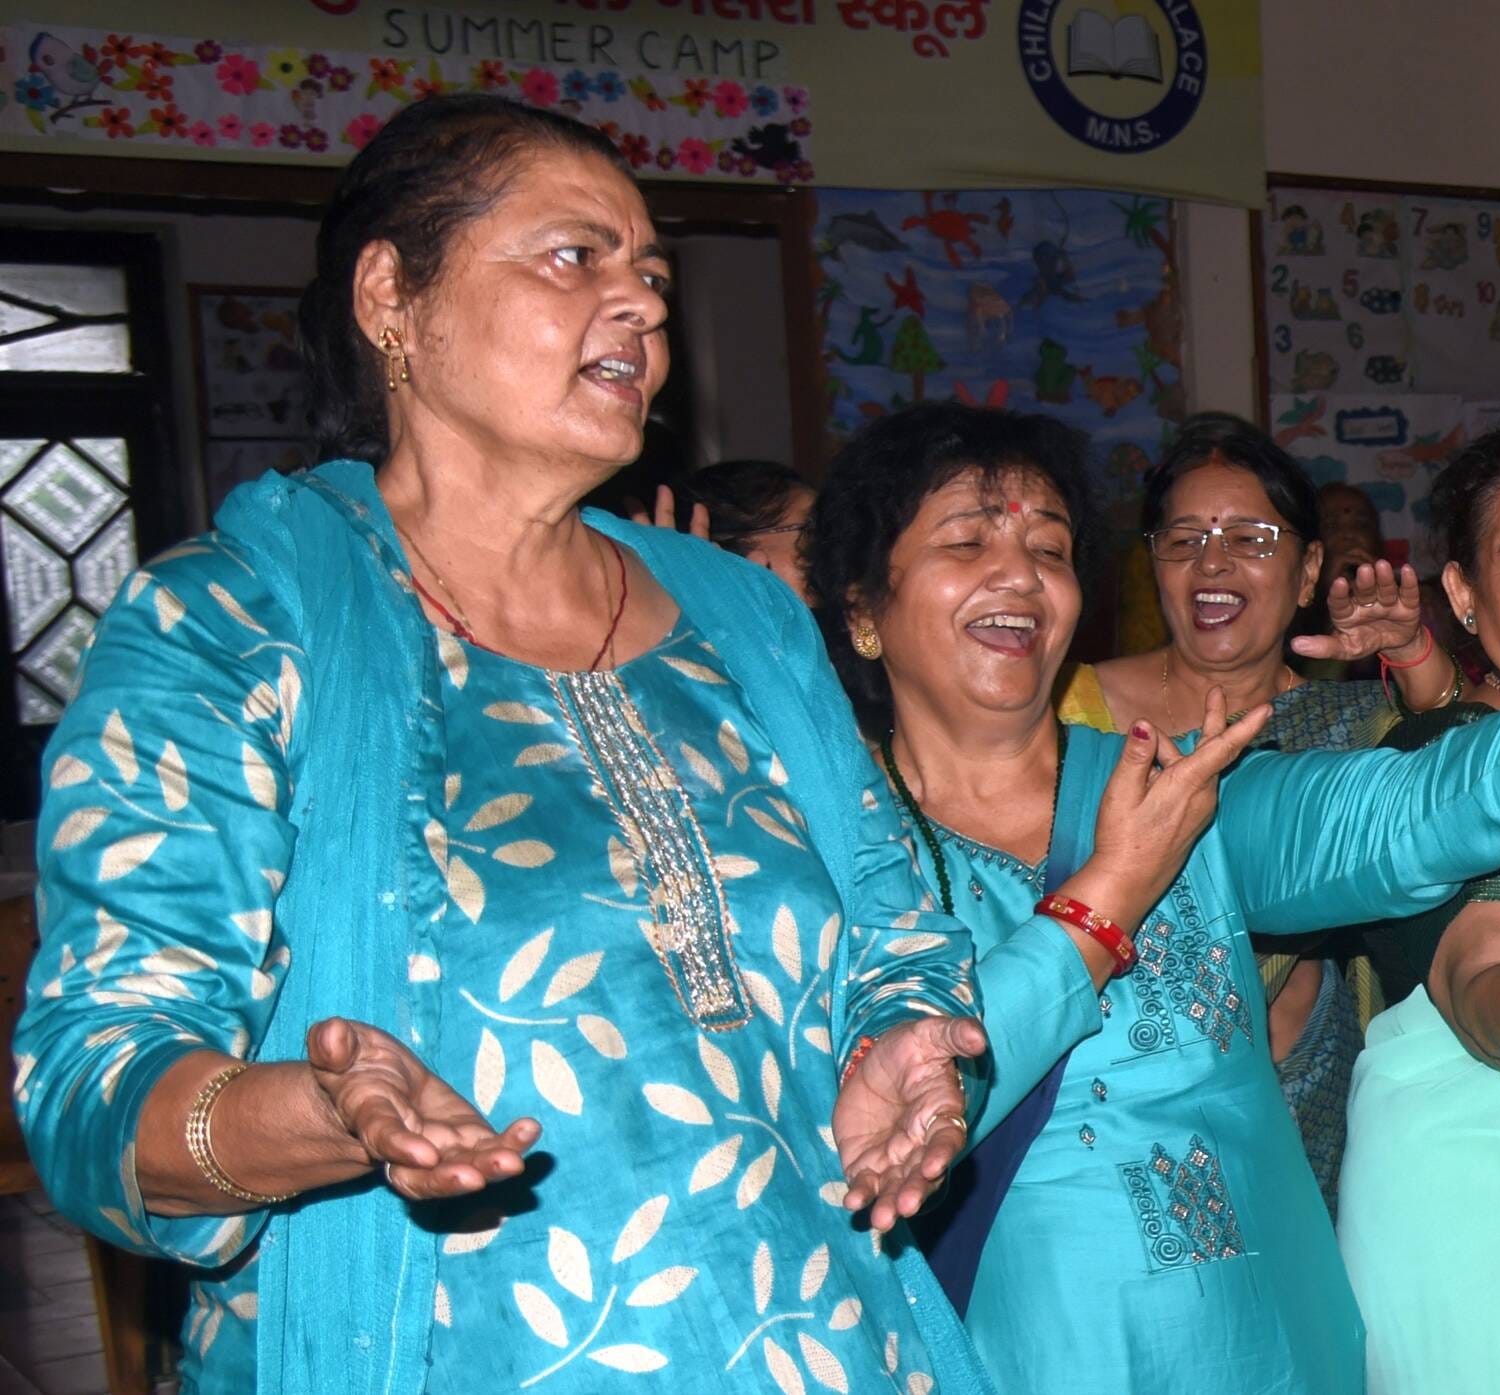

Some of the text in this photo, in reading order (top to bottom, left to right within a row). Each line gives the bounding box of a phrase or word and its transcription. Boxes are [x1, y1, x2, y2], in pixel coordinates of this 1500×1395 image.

[383, 9, 780, 79] SUMMER CAMP
[1085, 115, 1161, 147] M.N.S.
[1411, 207, 1429, 236] 7
[1477, 211, 1491, 238] 9
[1271, 264, 1289, 293] 2
[1342, 269, 1360, 299] 5
[1476, 281, 1496, 304] 10
[1274, 324, 1292, 353] 3
[1346, 322, 1365, 350] 6
